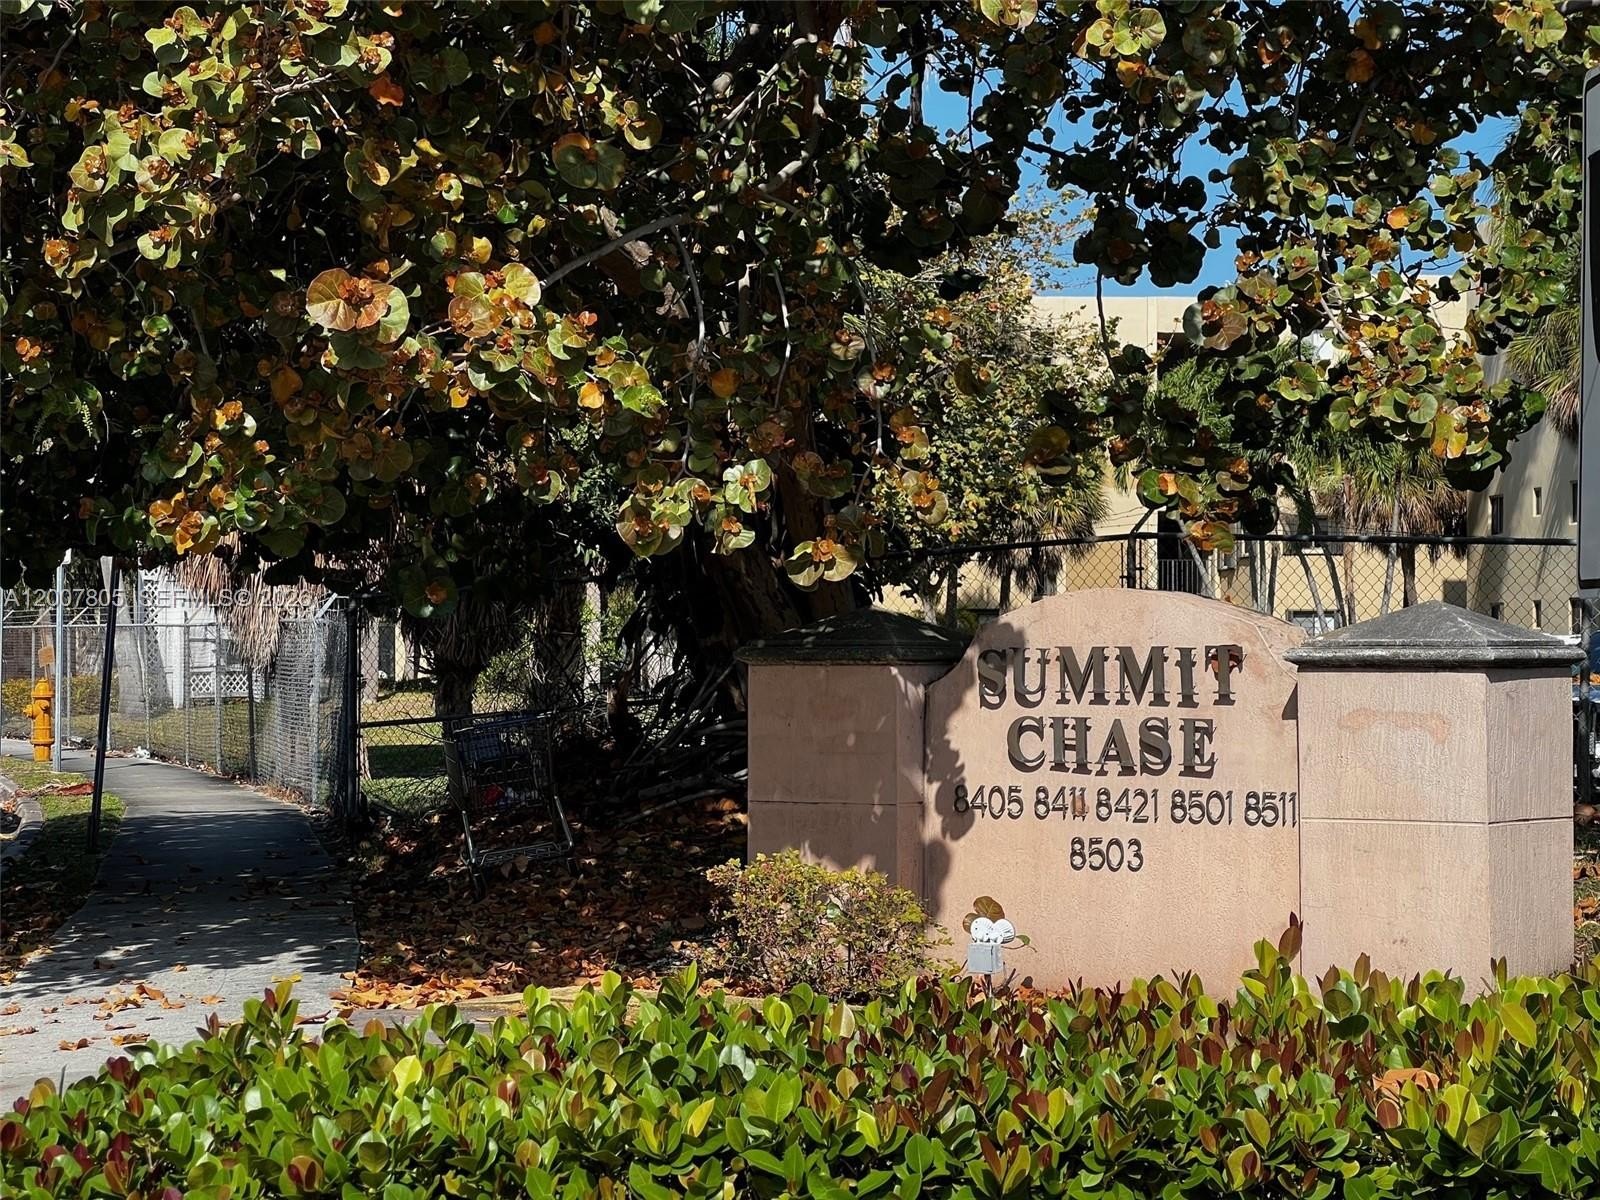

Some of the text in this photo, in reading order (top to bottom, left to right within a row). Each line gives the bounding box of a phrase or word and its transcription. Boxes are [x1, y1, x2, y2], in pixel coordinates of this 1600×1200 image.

[978, 645, 1243, 708] SUMMIT
[1006, 715, 1216, 778] CHASE
[953, 784, 1297, 828] 8405 8411 8421 8501 8511
[1070, 836, 1144, 873] 8503
